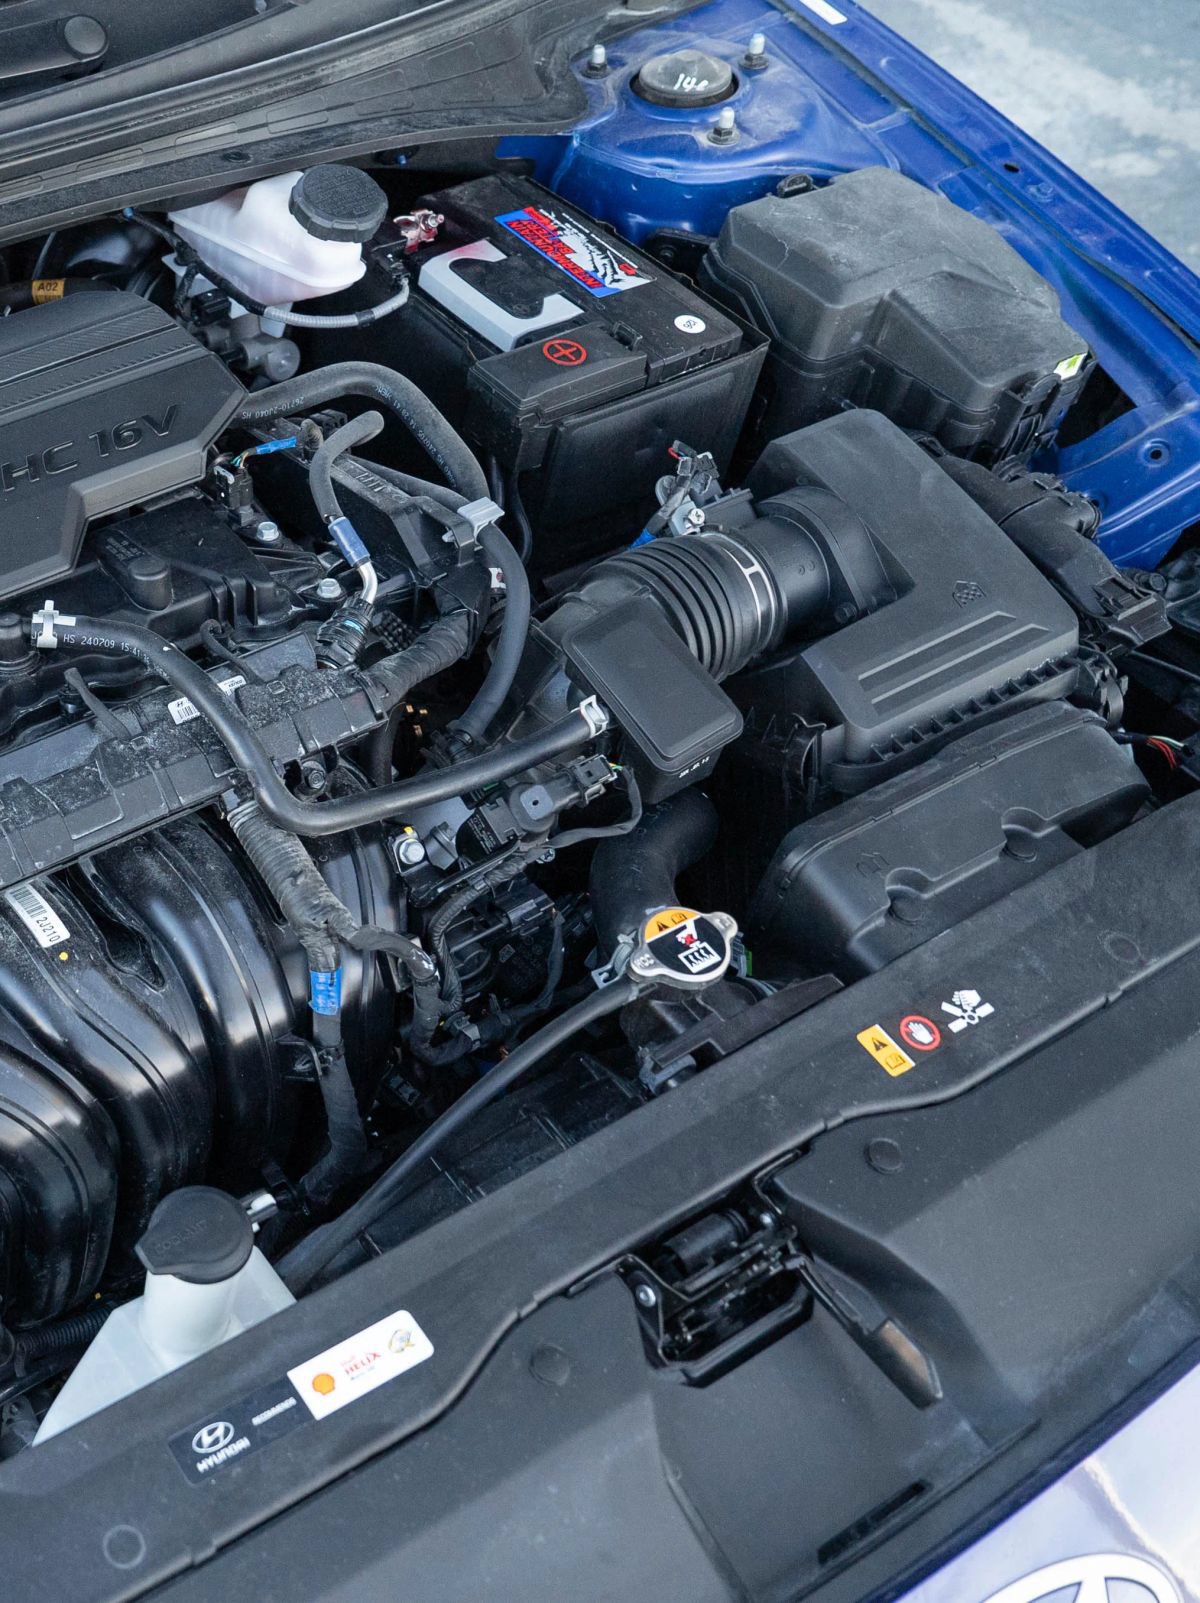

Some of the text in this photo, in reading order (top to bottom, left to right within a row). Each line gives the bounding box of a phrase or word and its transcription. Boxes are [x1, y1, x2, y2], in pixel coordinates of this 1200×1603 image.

[506, 219, 604, 288] INTERMOUNTAIN
[88, 404, 178, 458] 16V
[63, 634, 75, 644] HS
[81, 636, 115, 649] 240709
[36, 916, 61, 943] 2J210
[196, 1436, 251, 1474] HYUNDAI
